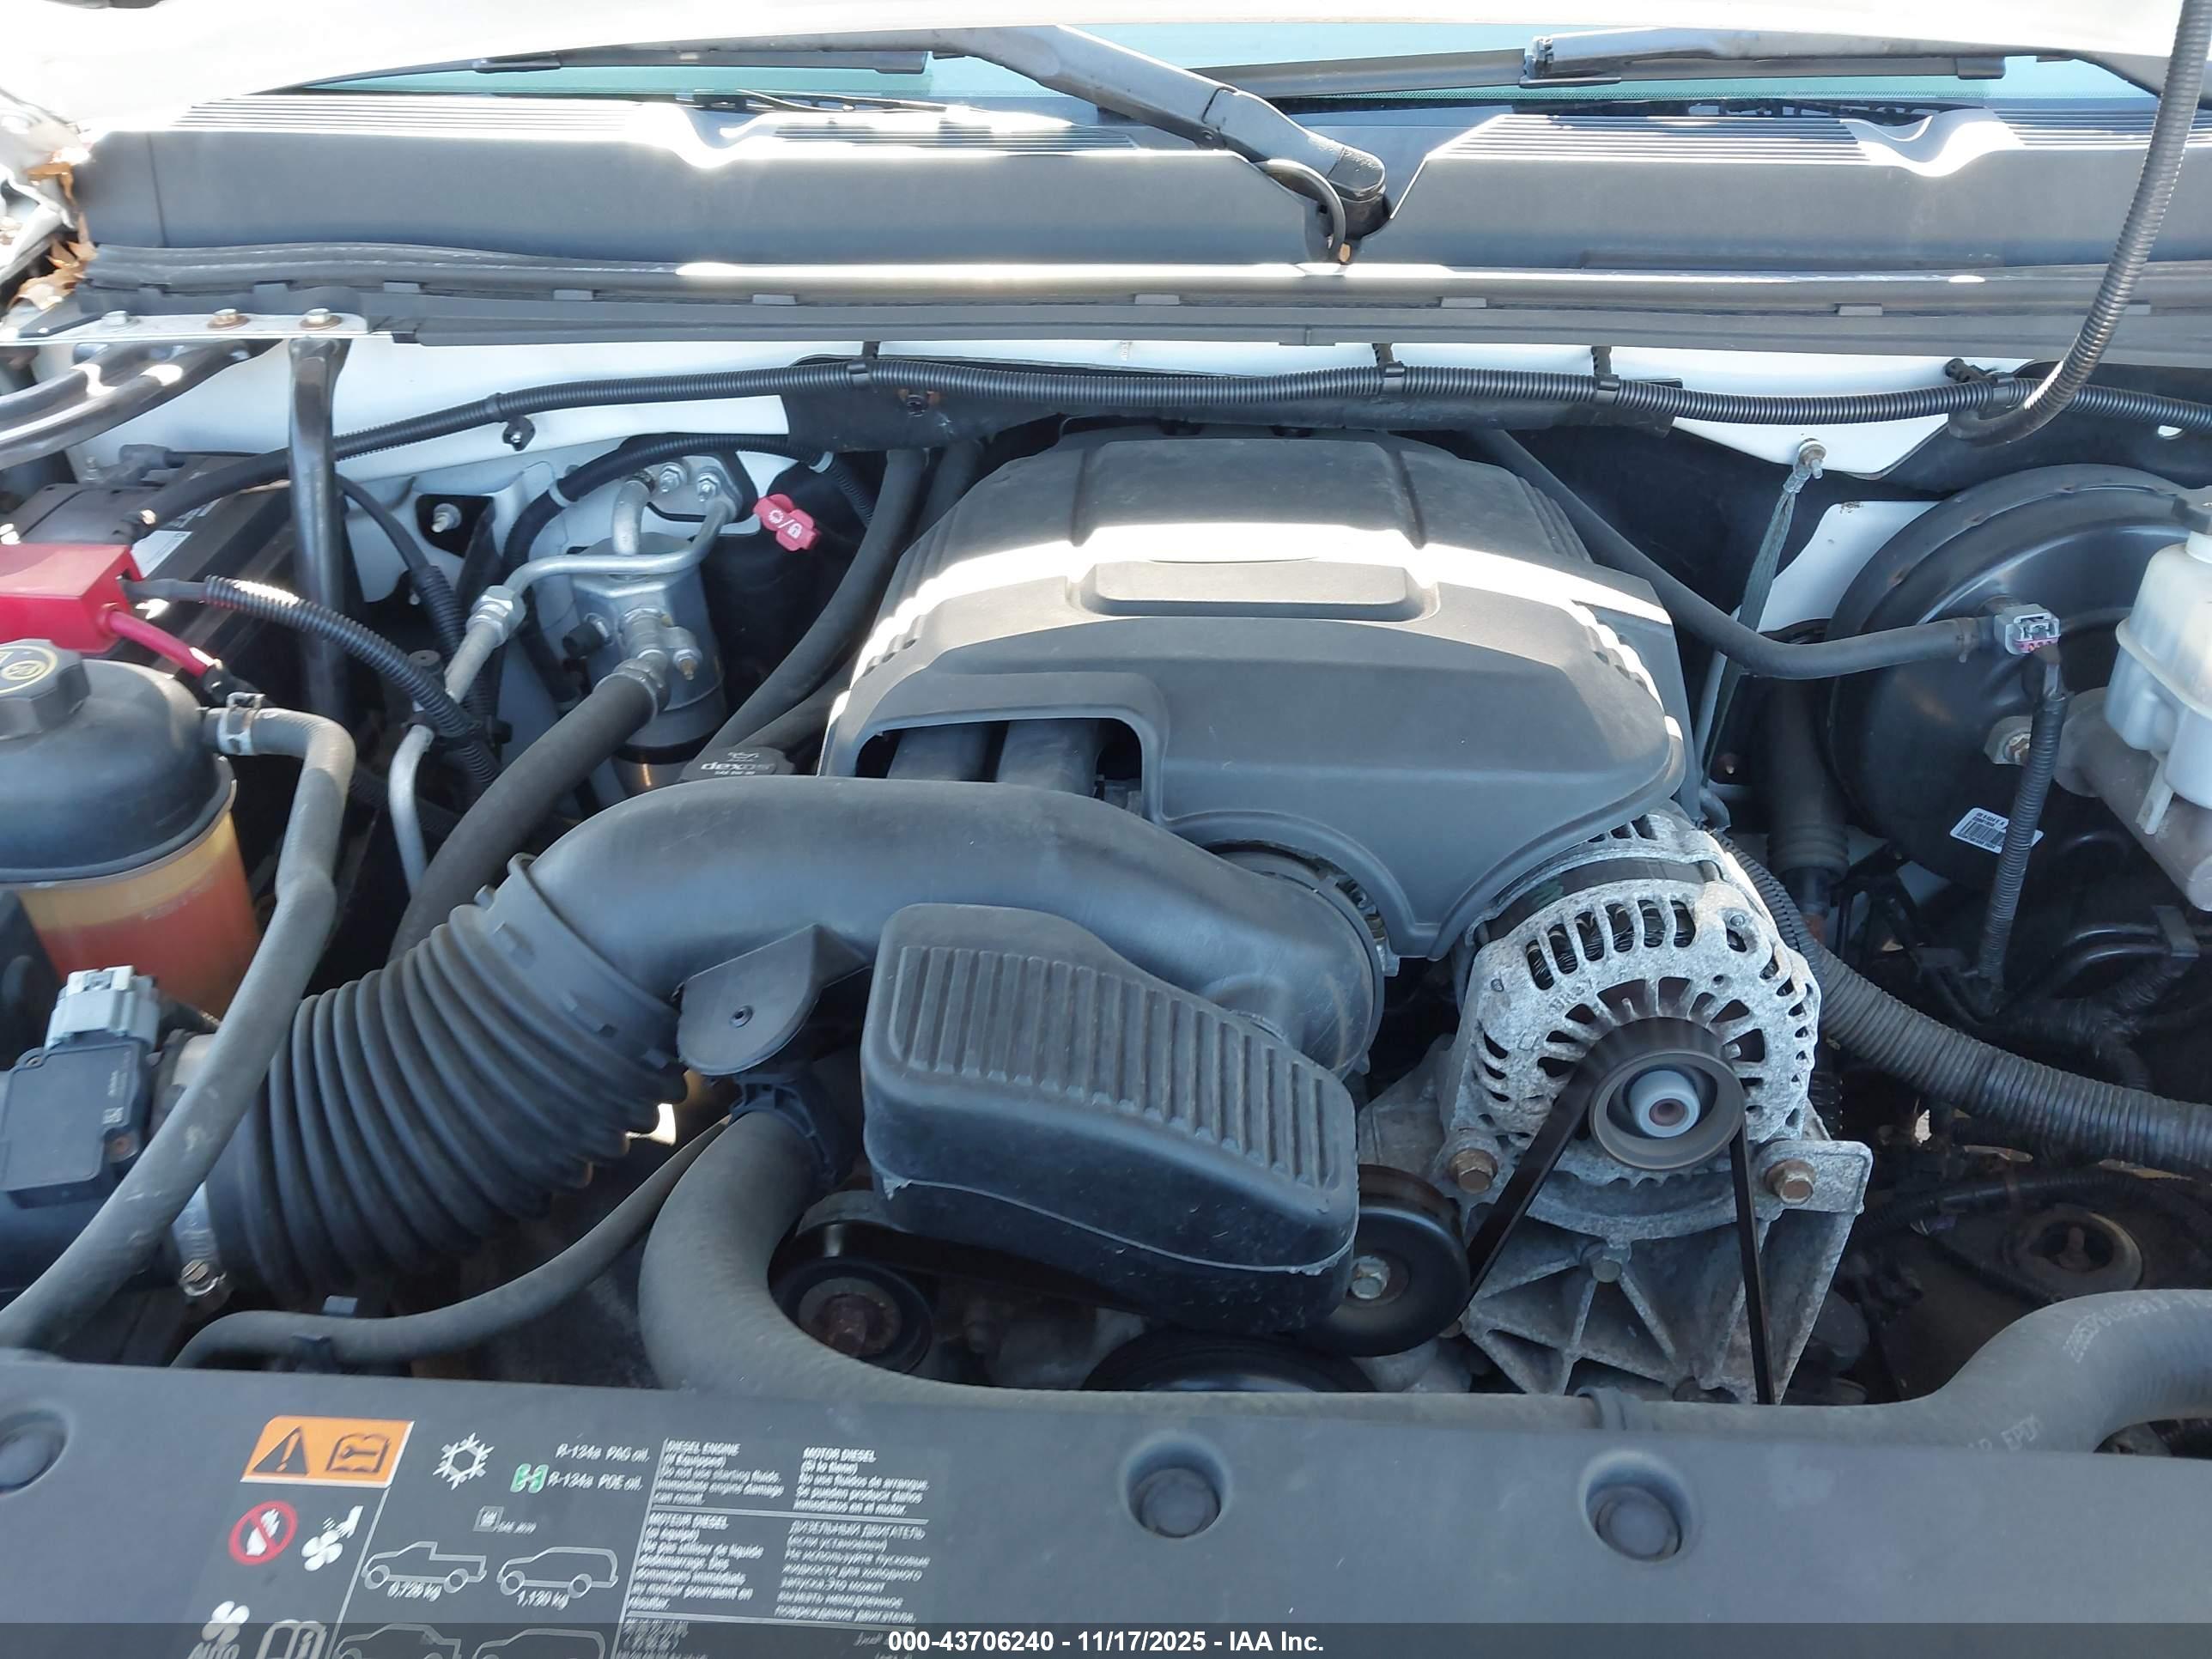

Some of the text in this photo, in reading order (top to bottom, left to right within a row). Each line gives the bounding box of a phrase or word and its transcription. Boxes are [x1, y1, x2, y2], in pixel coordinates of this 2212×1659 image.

[665, 1440, 741, 1456] DIESEL ENGINE
[803, 1447, 877, 1462] MOTOR DIESEL
[744, 1483, 784, 1498] damage
